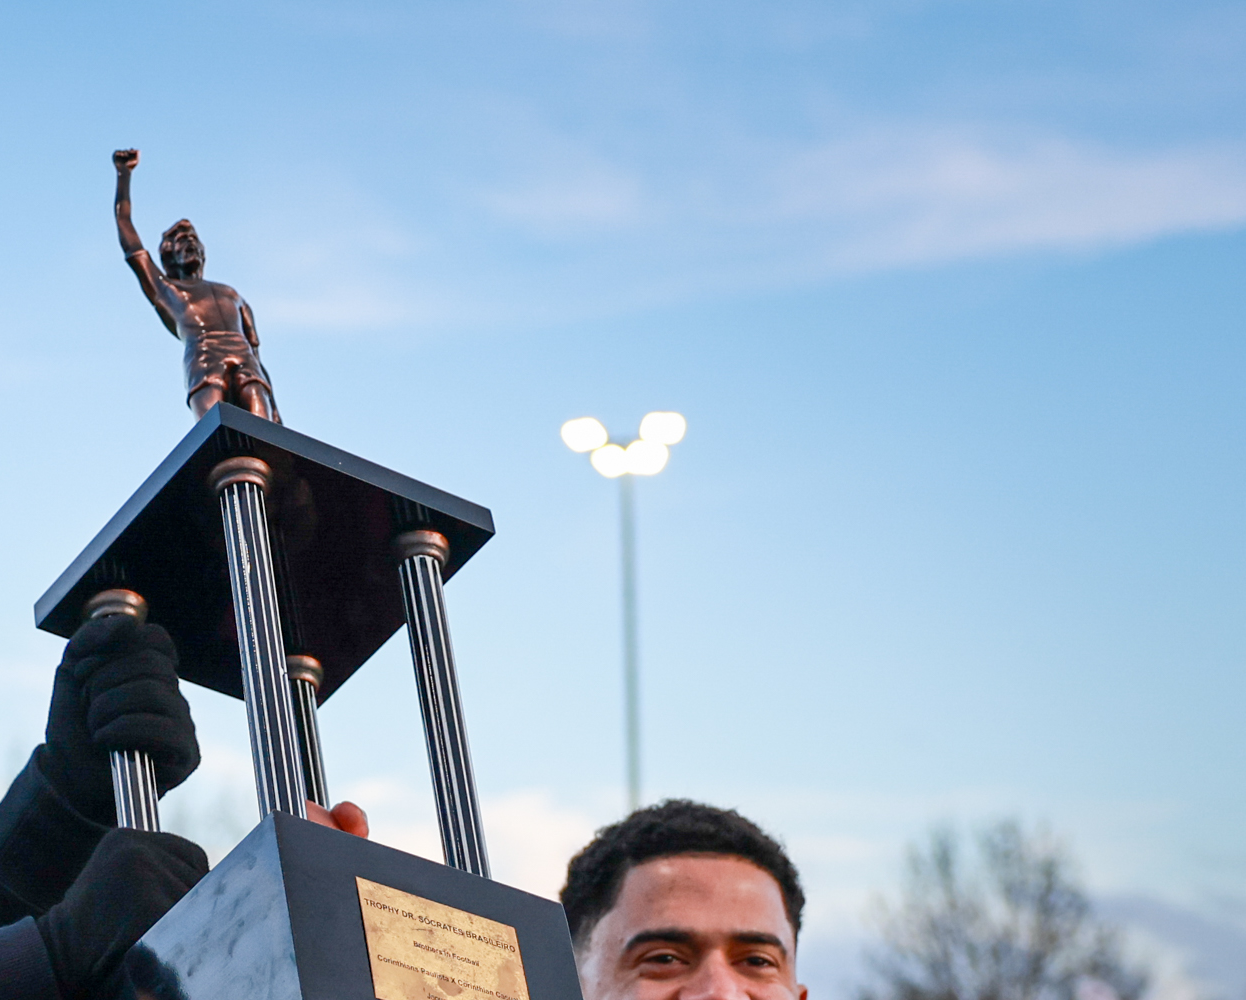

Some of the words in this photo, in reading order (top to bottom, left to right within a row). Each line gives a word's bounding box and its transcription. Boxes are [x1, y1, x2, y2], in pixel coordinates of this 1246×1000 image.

[364, 897, 399, 915] TROPHY
[401, 909, 416, 921] DR.
[465, 930, 516, 953] BRASILEIRO
[377, 953, 418, 972] Corinthians
[420, 967, 449, 982] Paulista
[457, 978, 493, 995] Corinthian
[413, 940, 442, 955] Brothers
[451, 952, 479, 967] Football
